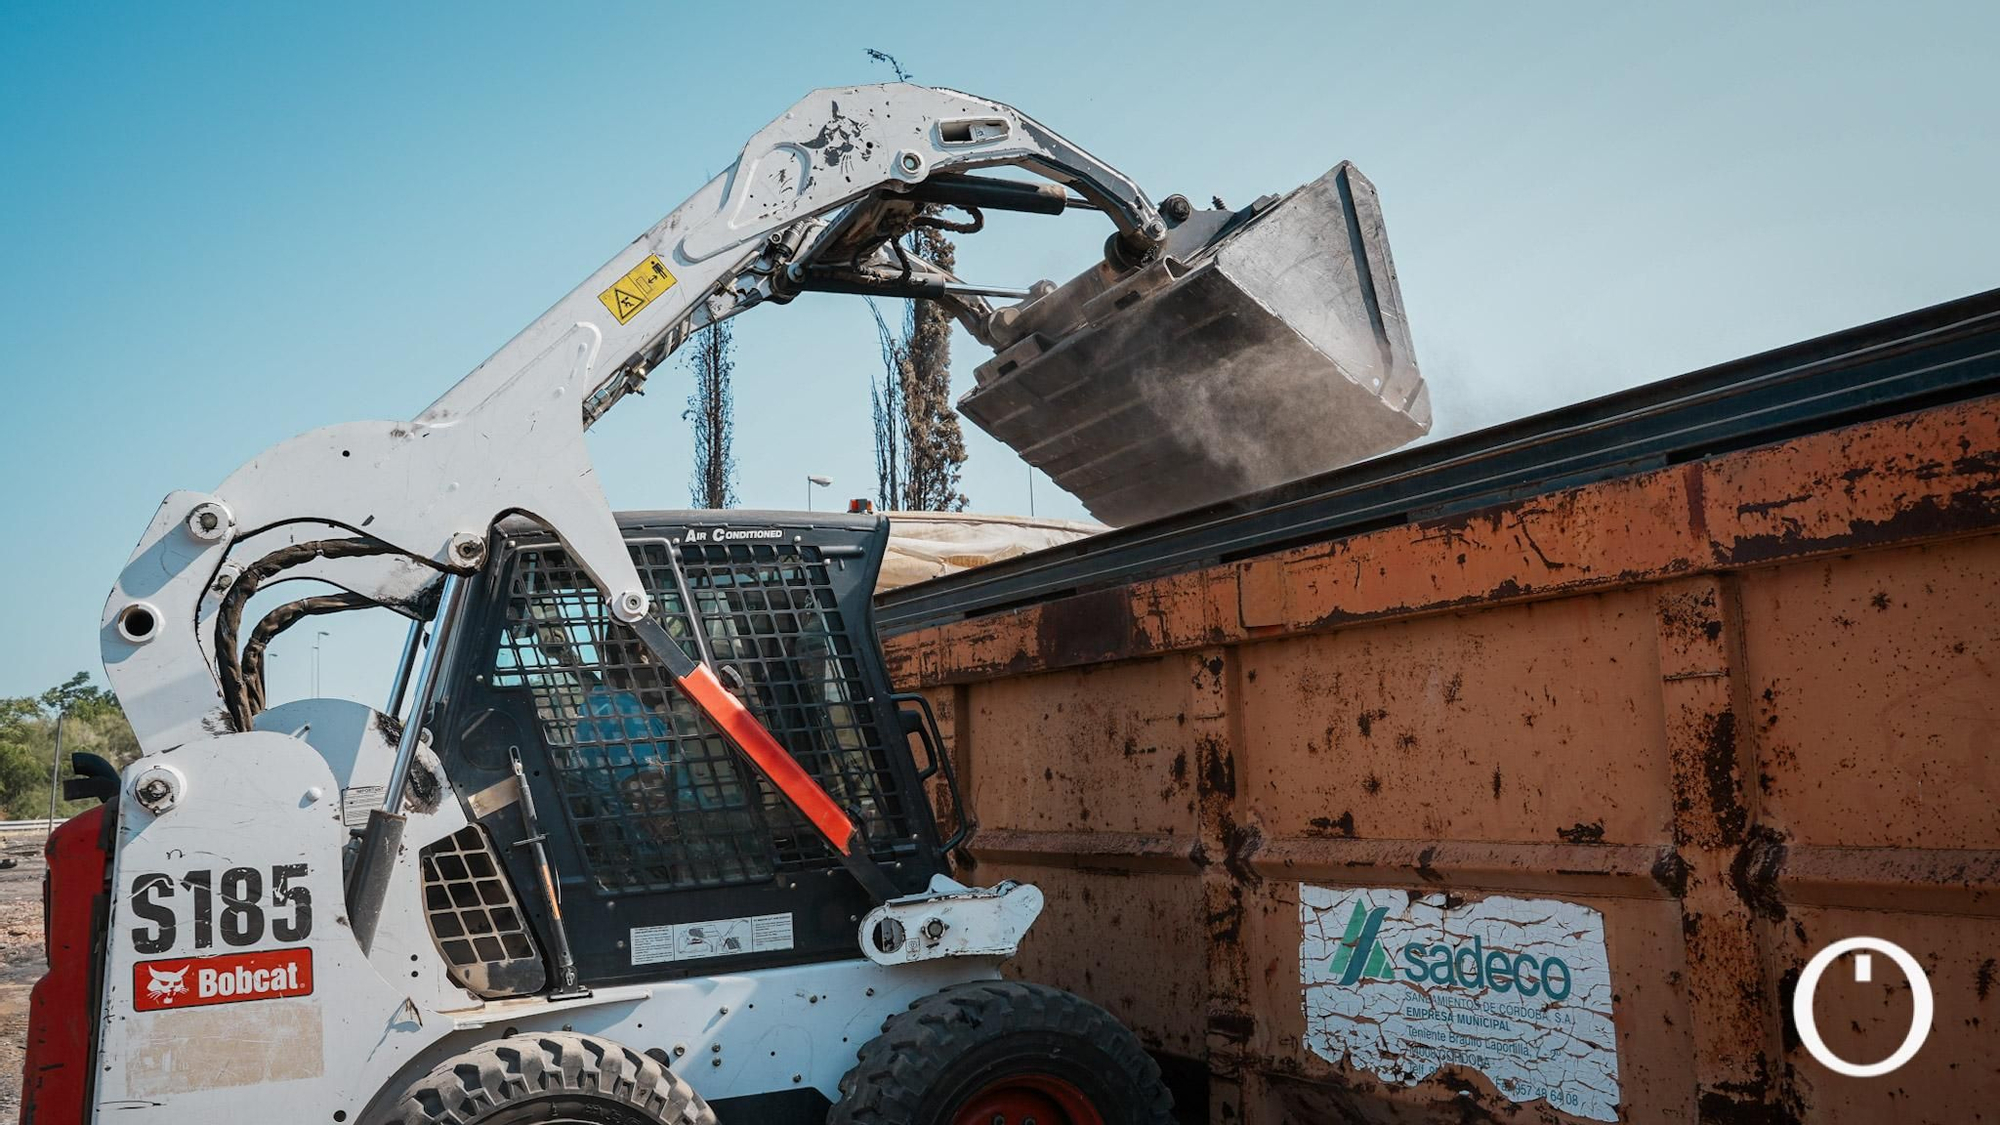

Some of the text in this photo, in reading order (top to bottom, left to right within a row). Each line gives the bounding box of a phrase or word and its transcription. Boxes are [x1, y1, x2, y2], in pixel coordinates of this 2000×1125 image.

[131, 863, 312, 955] S185
[198, 962, 299, 998] Bobcat
[1404, 935, 1571, 1001] sadeco
[1406, 1006, 1512, 1032] EMPRESA MUNICIPAL
[1483, 1001, 1496, 1013] DE
[1405, 1025, 1446, 1042] Teniente
[1535, 1087, 1548, 1098] 48
[1550, 1089, 1563, 1102] 64
[1565, 1093, 1579, 1106] 08
